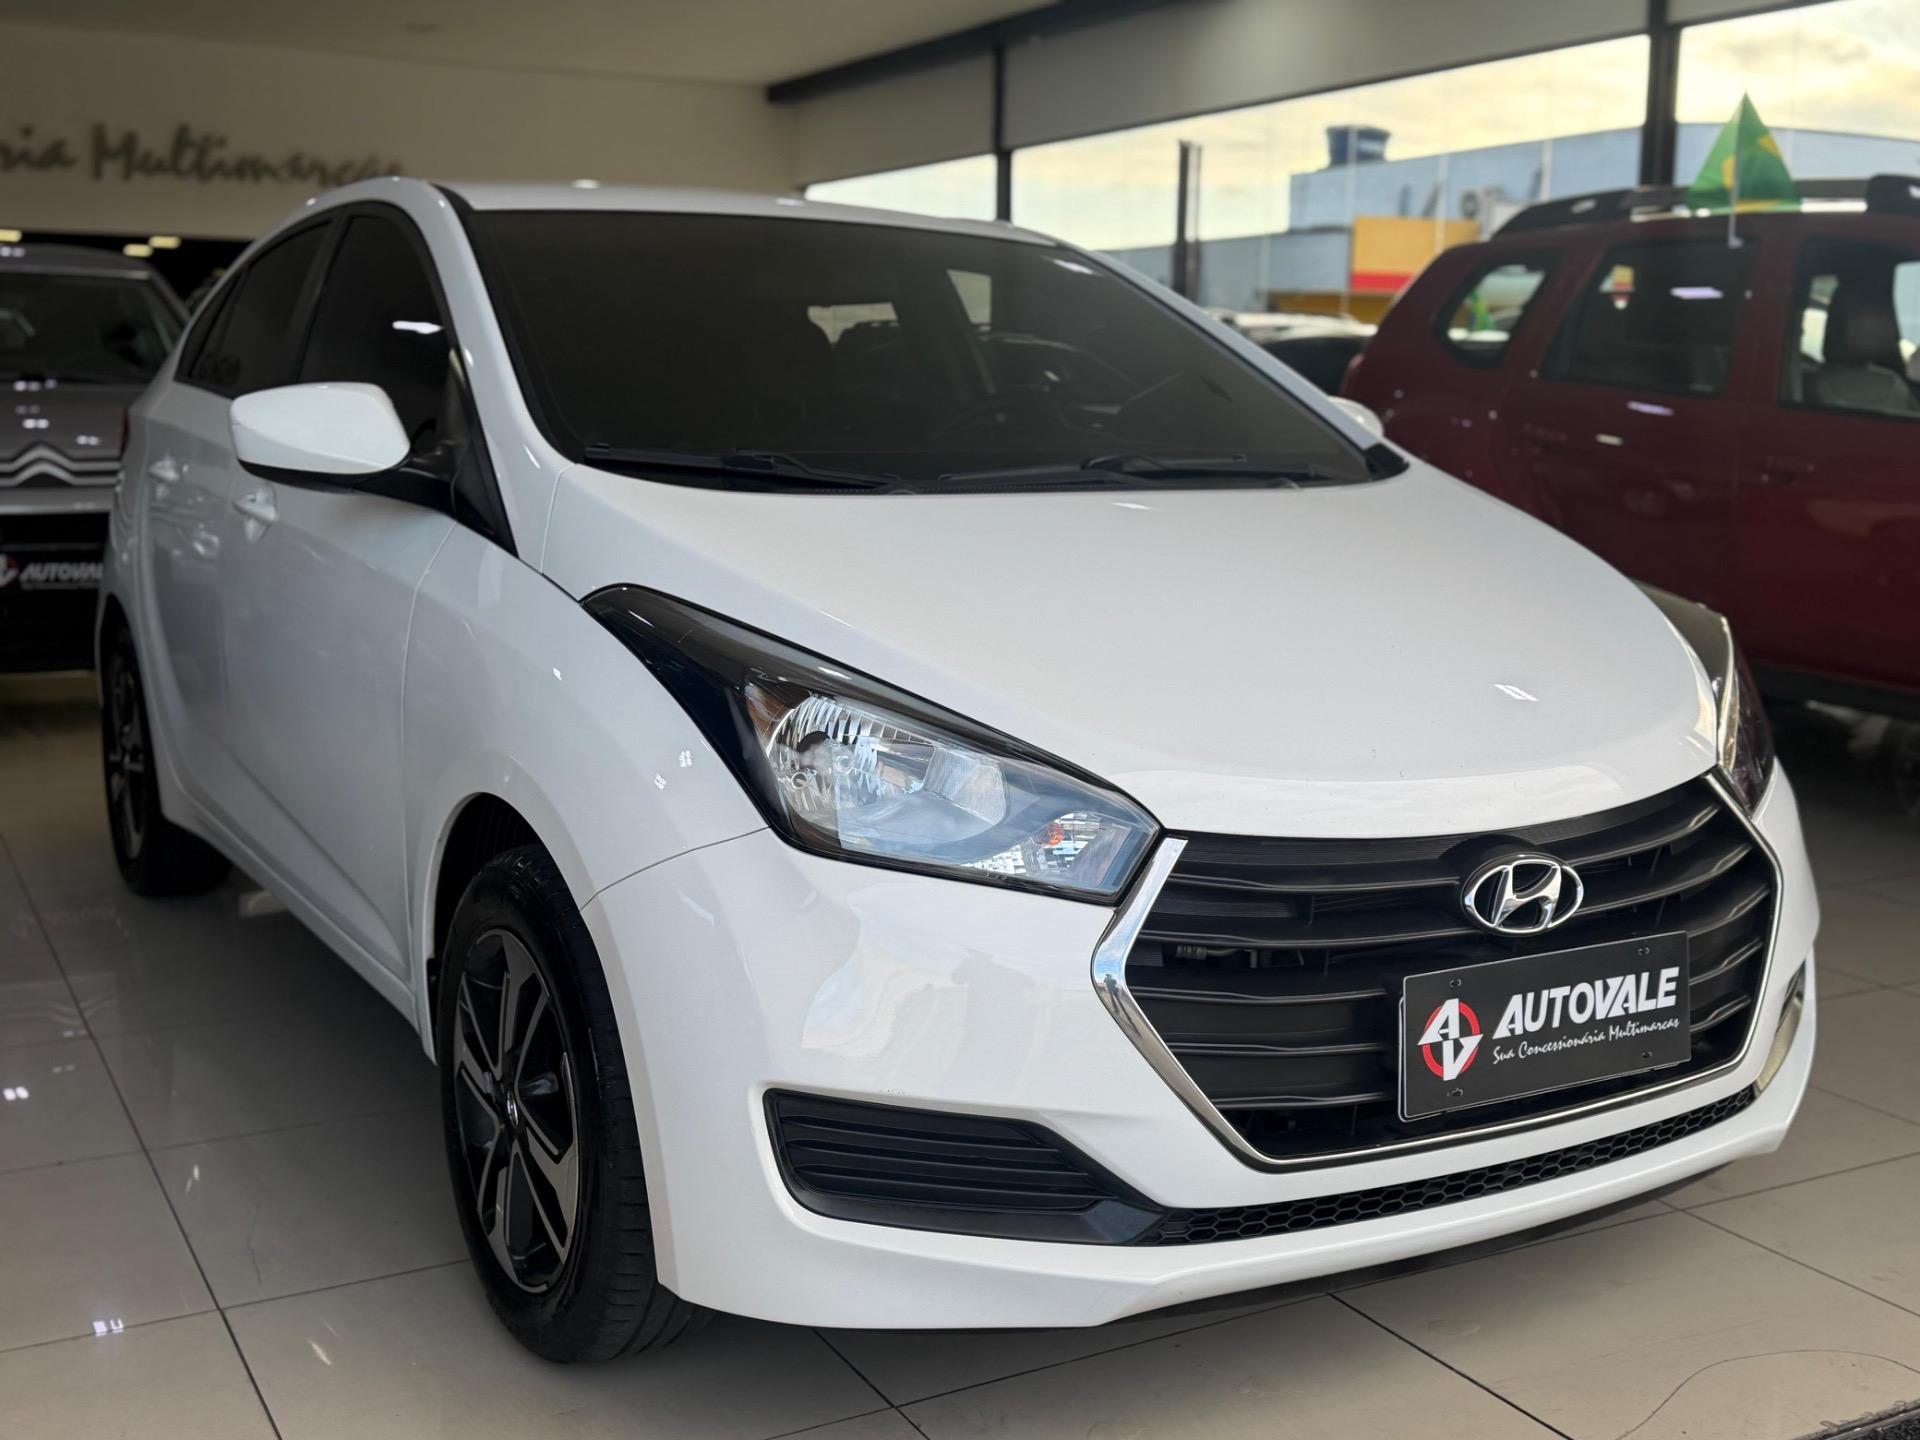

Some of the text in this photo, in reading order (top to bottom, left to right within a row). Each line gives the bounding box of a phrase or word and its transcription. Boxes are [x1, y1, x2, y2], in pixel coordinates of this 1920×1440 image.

[1492, 966, 1680, 1040] AUTOVALE
[1493, 1017, 1680, 1065] Sua Concessionária Multimarcas
